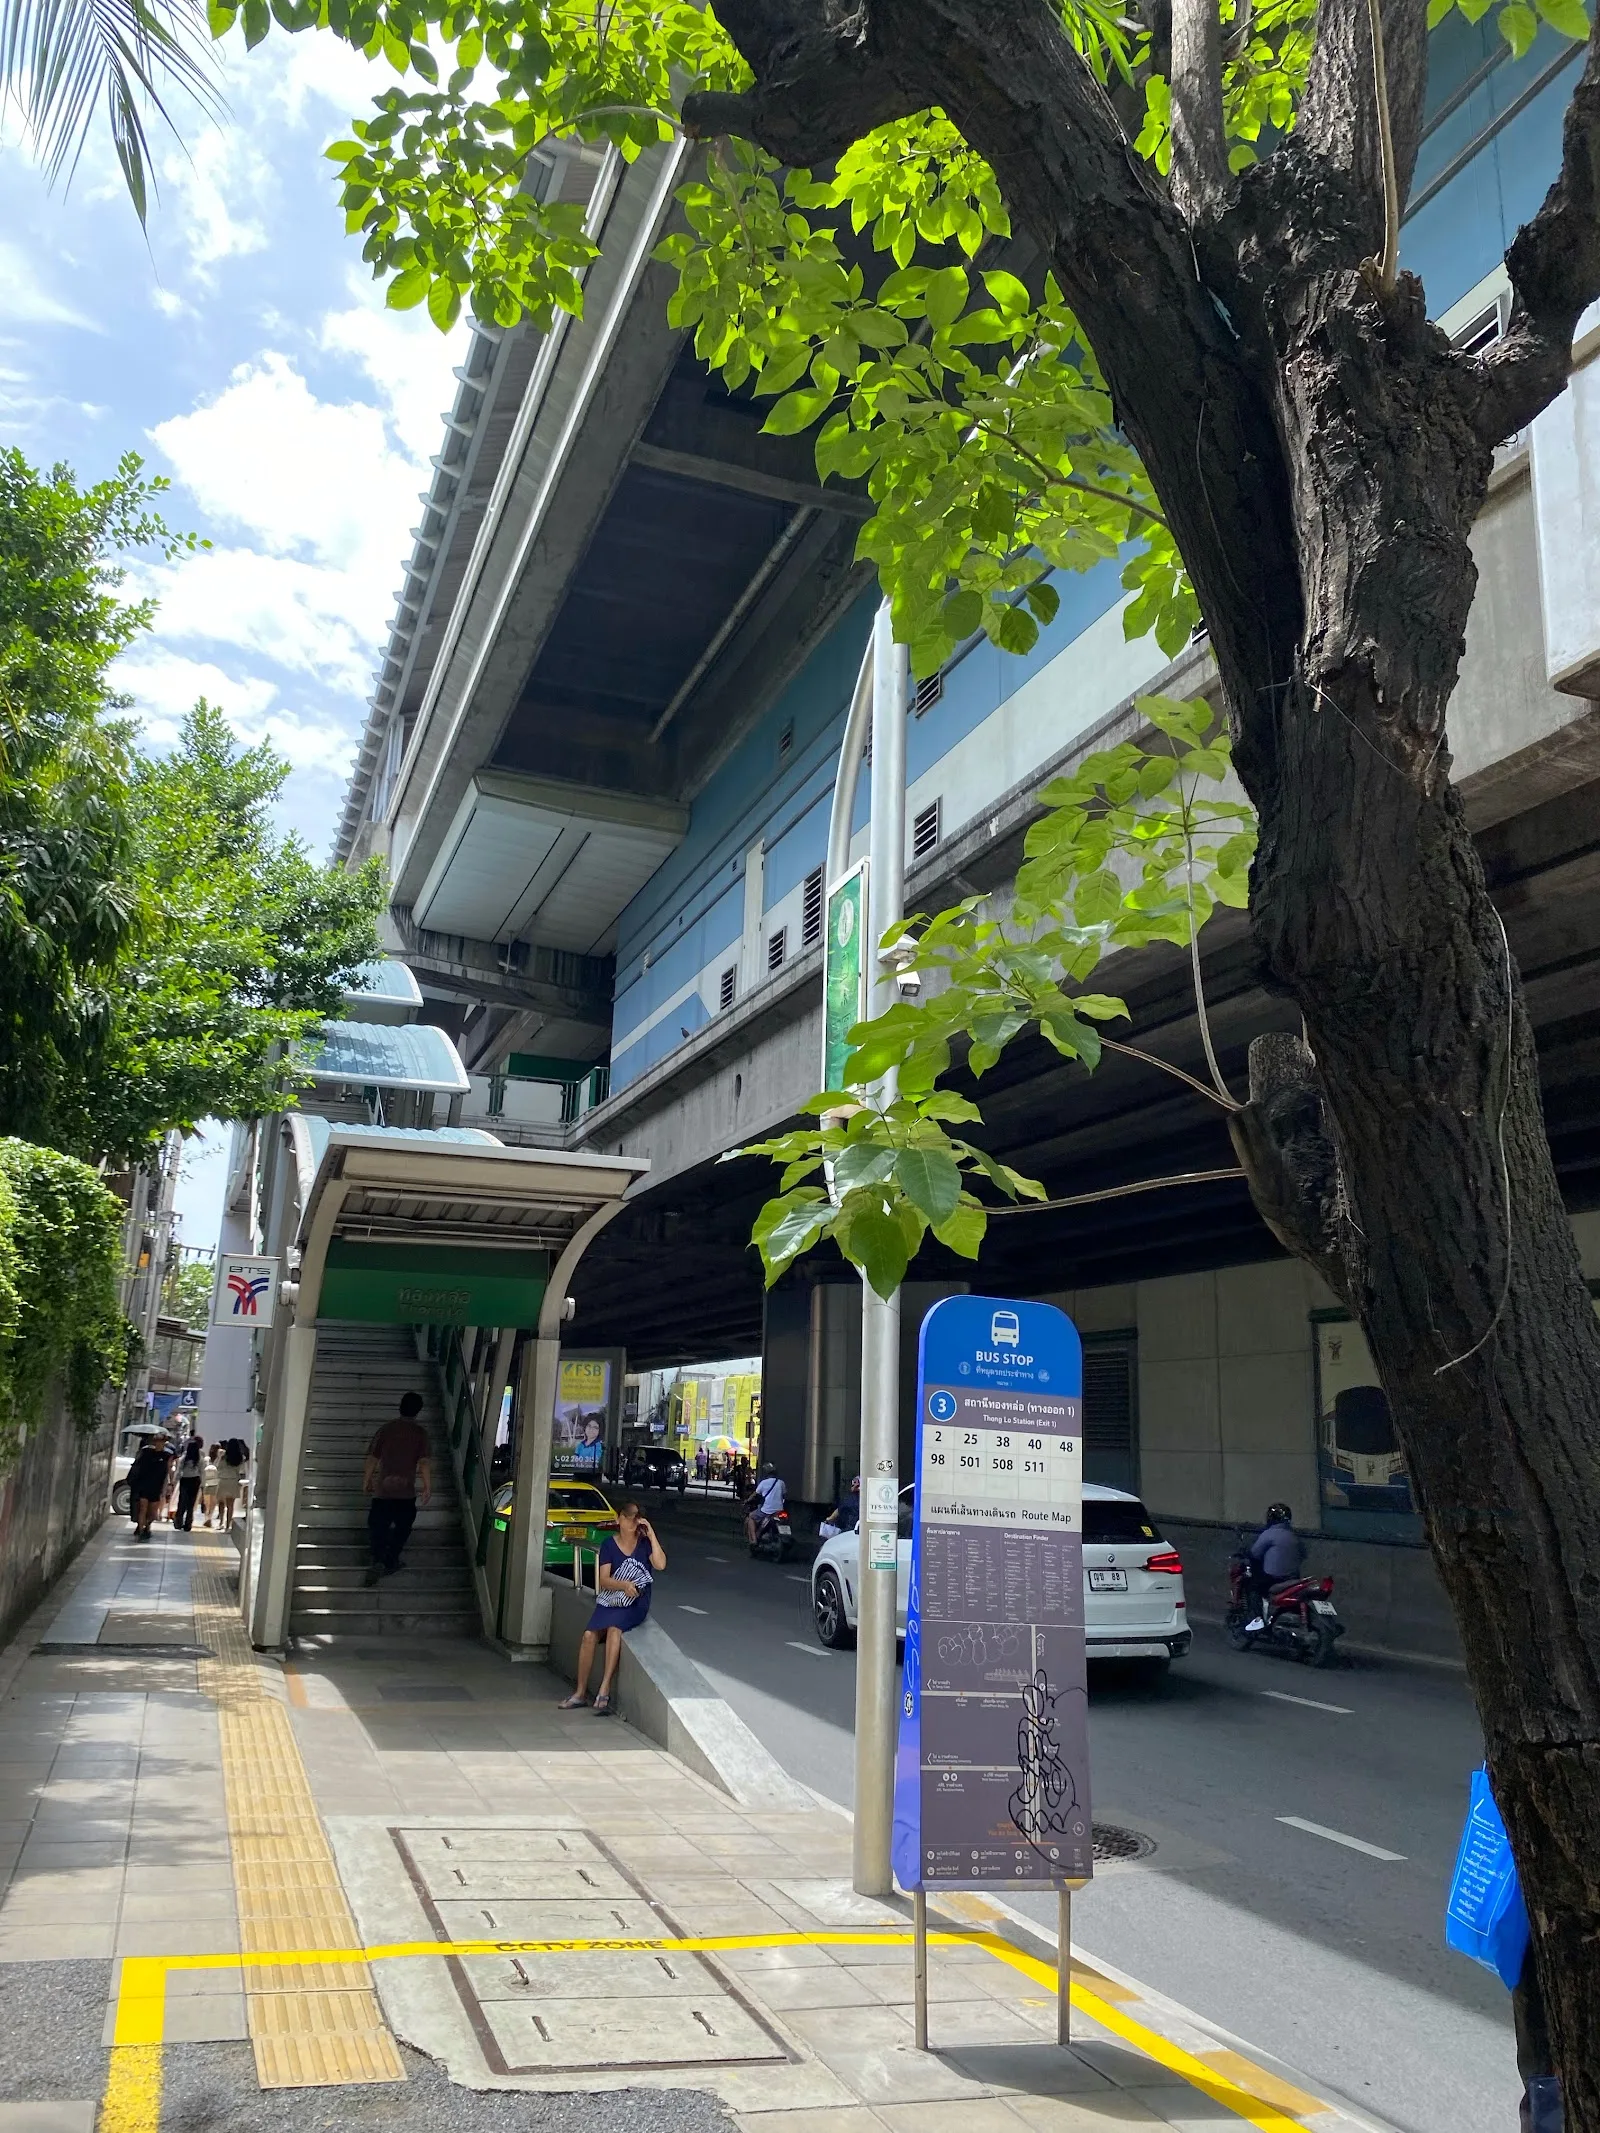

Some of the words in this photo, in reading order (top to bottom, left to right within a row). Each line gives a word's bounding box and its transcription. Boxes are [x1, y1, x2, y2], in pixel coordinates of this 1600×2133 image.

[229, 1265, 271, 1275] BTS
[976, 1350, 1000, 1364] BUS
[1002, 1353, 1034, 1367] STOP
[576, 1364, 602, 1377] FSB
[937, 1398, 947, 1413] 3
[964, 1397, 1025, 1412] สถานีทองหล่อ
[1027, 1402, 1065, 1416] (ทางออก
[1067, 1406, 1075, 1418] 1)
[983, 1414, 1003, 1424] Thong
[1003, 1416, 1012, 1424] Lo
[1013, 1417, 1035, 1426] Station
[1036, 1419, 1051, 1428] (Exit
[1052, 1420, 1057, 1428] 1)
[935, 1431, 942, 1442] 2
[963, 1433, 978, 1445] 25
[996, 1436, 1010, 1448] 38
[1027, 1439, 1042, 1450] 40
[1059, 1441, 1074, 1453] 48
[930, 1453, 945, 1465] 98
[960, 1456, 980, 1468] 501
[992, 1458, 1013, 1471] 508
[1024, 1461, 1044, 1473] 511
[930, 1502, 1016, 1519] แผนที่เส้นทางเดินรถ
[1021, 1510, 1049, 1521] Route
[1051, 1511, 1072, 1524] Map
[495, 1942, 574, 1952] CCTV
[588, 1940, 669, 1950] ZONE
